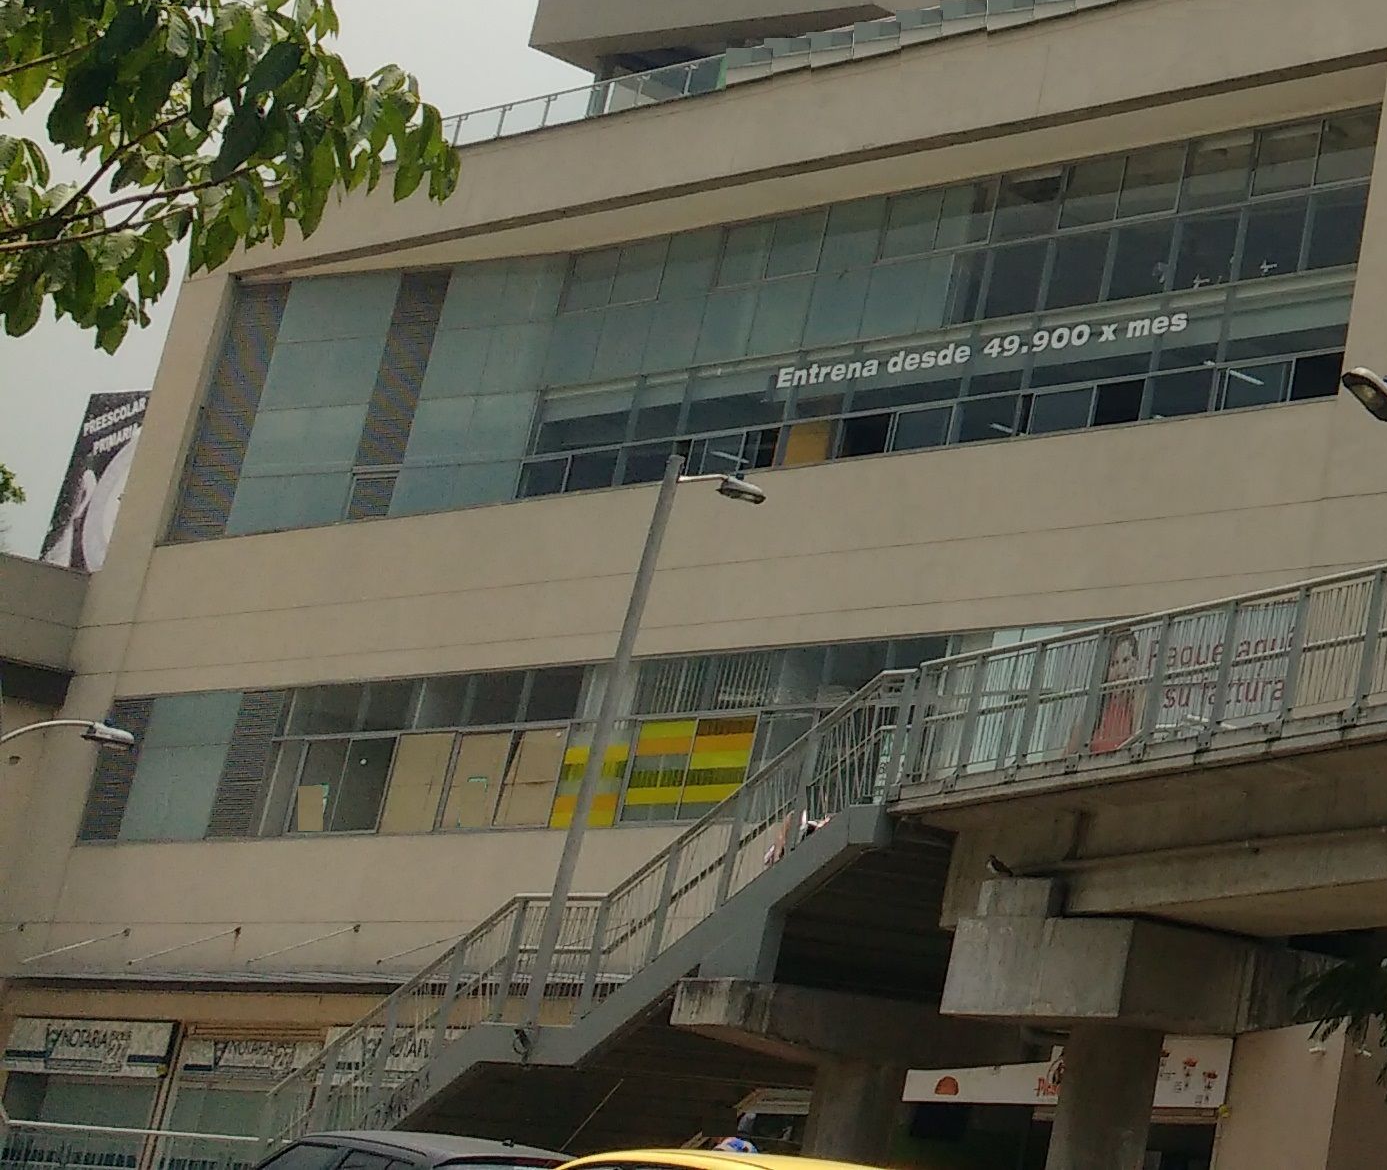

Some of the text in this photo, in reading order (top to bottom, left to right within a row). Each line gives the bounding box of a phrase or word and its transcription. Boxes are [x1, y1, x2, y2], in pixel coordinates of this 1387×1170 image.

[775, 312, 1188, 389] Entrena desde 49.900 x mes
[83, 397, 147, 437] PREESCOLAR
[1163, 687, 1192, 709] su
